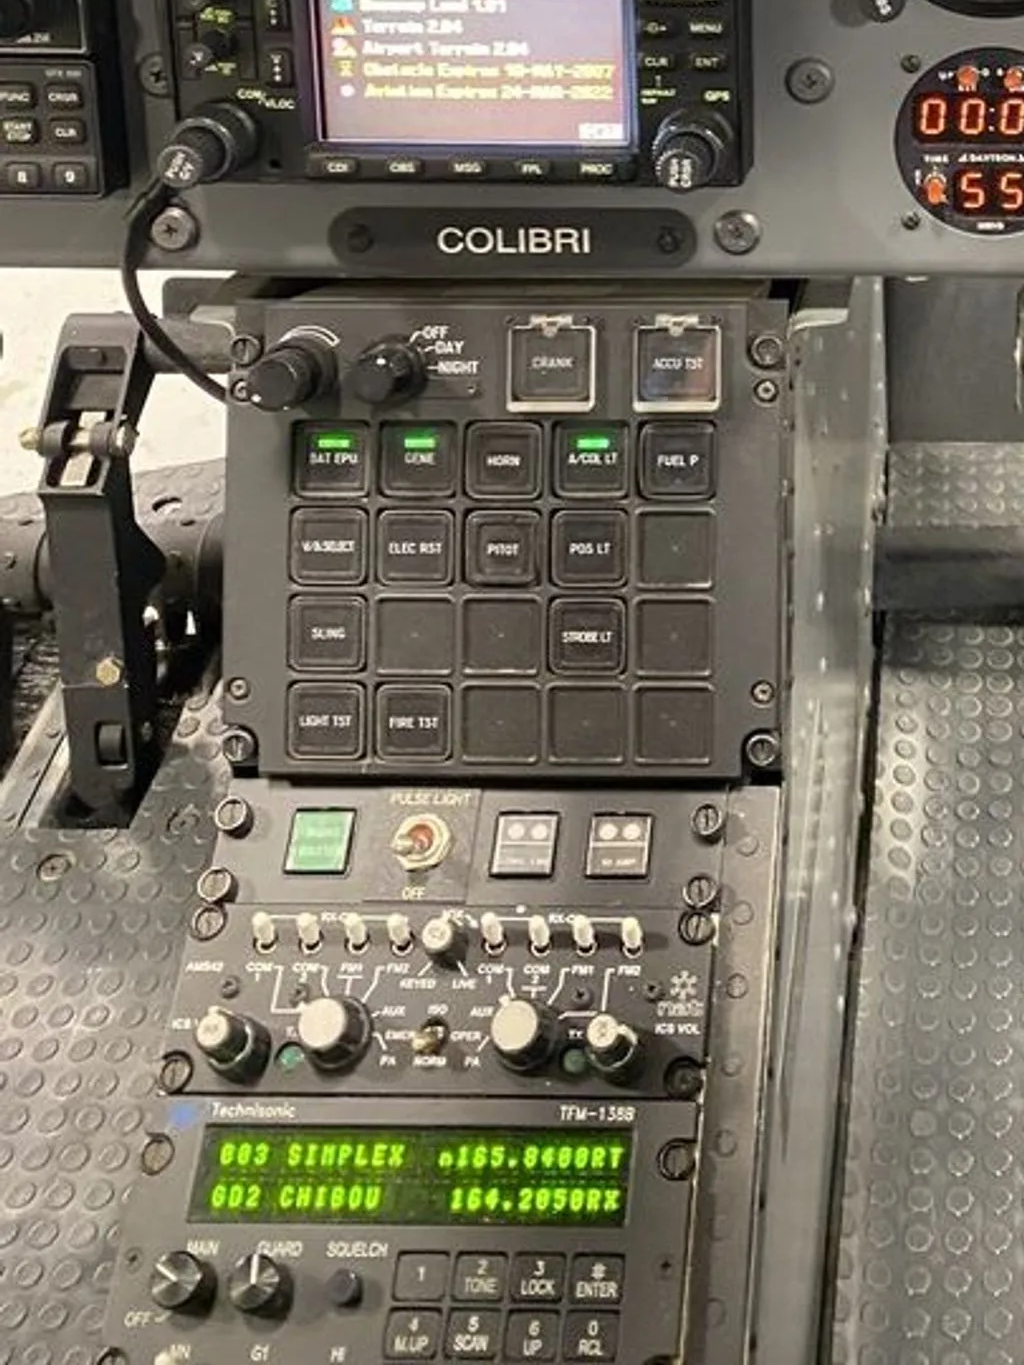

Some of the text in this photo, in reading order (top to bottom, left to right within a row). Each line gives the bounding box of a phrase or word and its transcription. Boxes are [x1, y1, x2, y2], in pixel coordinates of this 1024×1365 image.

[704, 90, 730, 102] GPS
[960, 173, 1024, 210] 55
[436, 227, 591, 254] COLIBRI
[423, 326, 449, 339] OFF
[435, 341, 464, 353] DAY
[437, 361, 479, 374] NIGHT
[531, 356, 574, 368] CRANK
[486, 455, 521, 467] HORN
[657, 455, 685, 467] FUEL
[487, 543, 519, 555] PITOT
[311, 627, 346, 640] SLING
[402, 887, 426, 900] OFF
[211, 1102, 296, 1119] Technisonic
[287, 1142, 406, 1166] SIMPLEX
[279, 1185, 382, 1209] CHIBOU
[187, 1241, 219, 1256] MAIN
[257, 1241, 303, 1256] GUARD
[326, 1241, 388, 1257] SQUELCH
[520, 1280, 555, 1295] LOCK
[575, 1282, 618, 1298] ENTER
[124, 1312, 151, 1327] OFF
[453, 1335, 489, 1352] SCAN
[523, 1339, 543, 1355] UP
